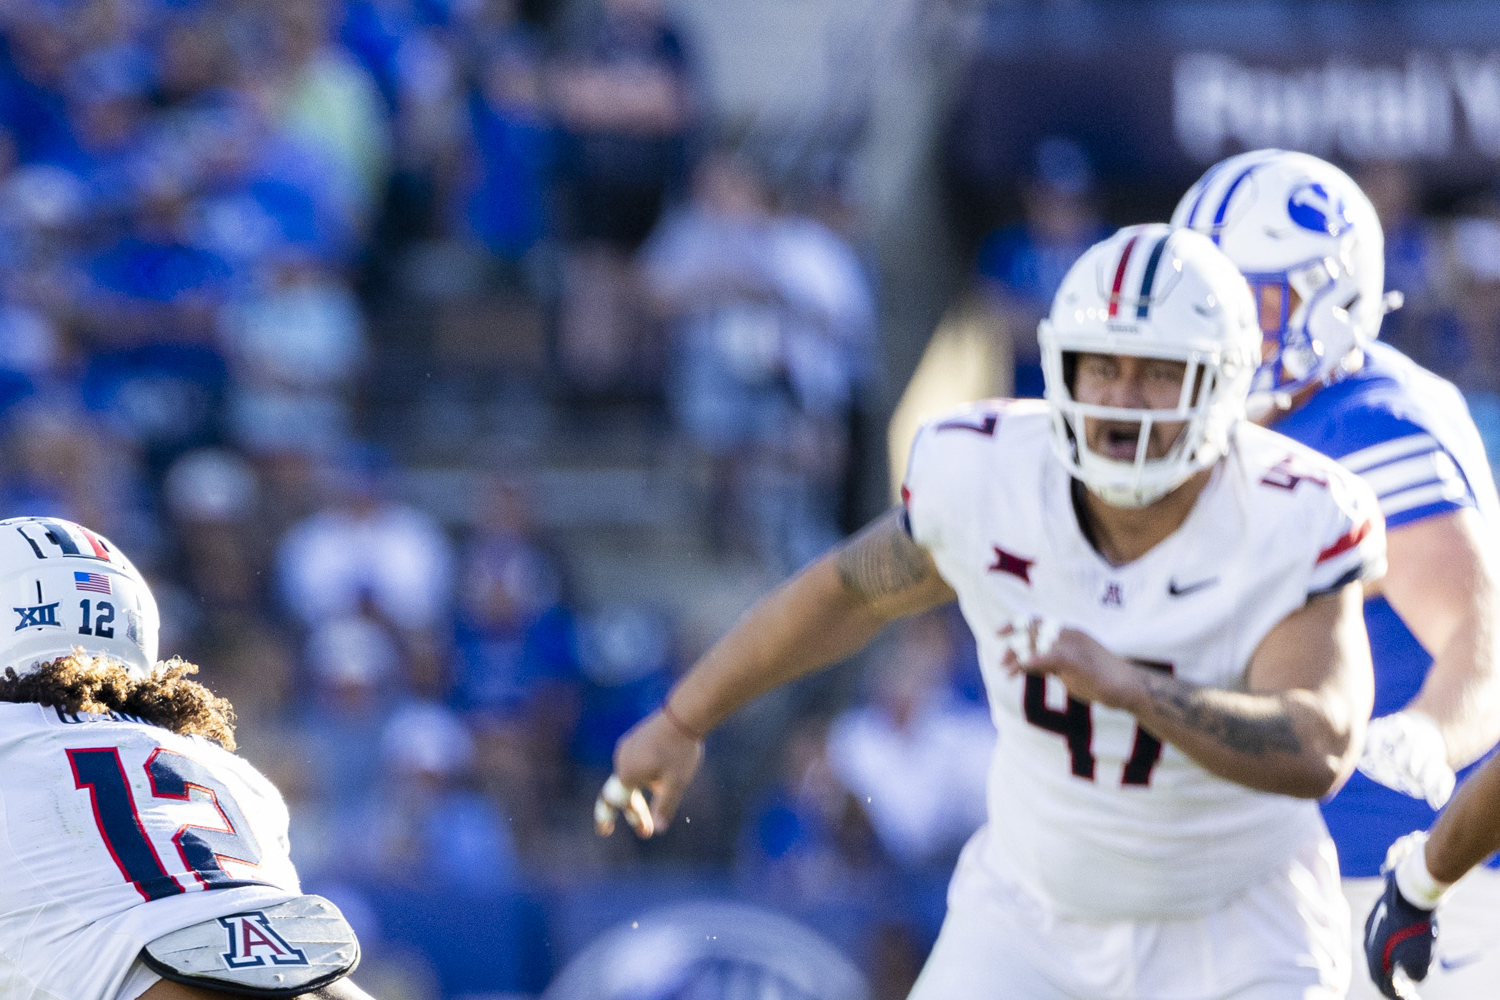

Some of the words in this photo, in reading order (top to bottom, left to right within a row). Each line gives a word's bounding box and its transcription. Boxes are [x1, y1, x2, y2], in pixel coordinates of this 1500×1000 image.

[13, 601, 61, 632] XII
[78, 599, 116, 639] 12
[64, 746, 288, 902] 12
[216, 910, 310, 969] A
